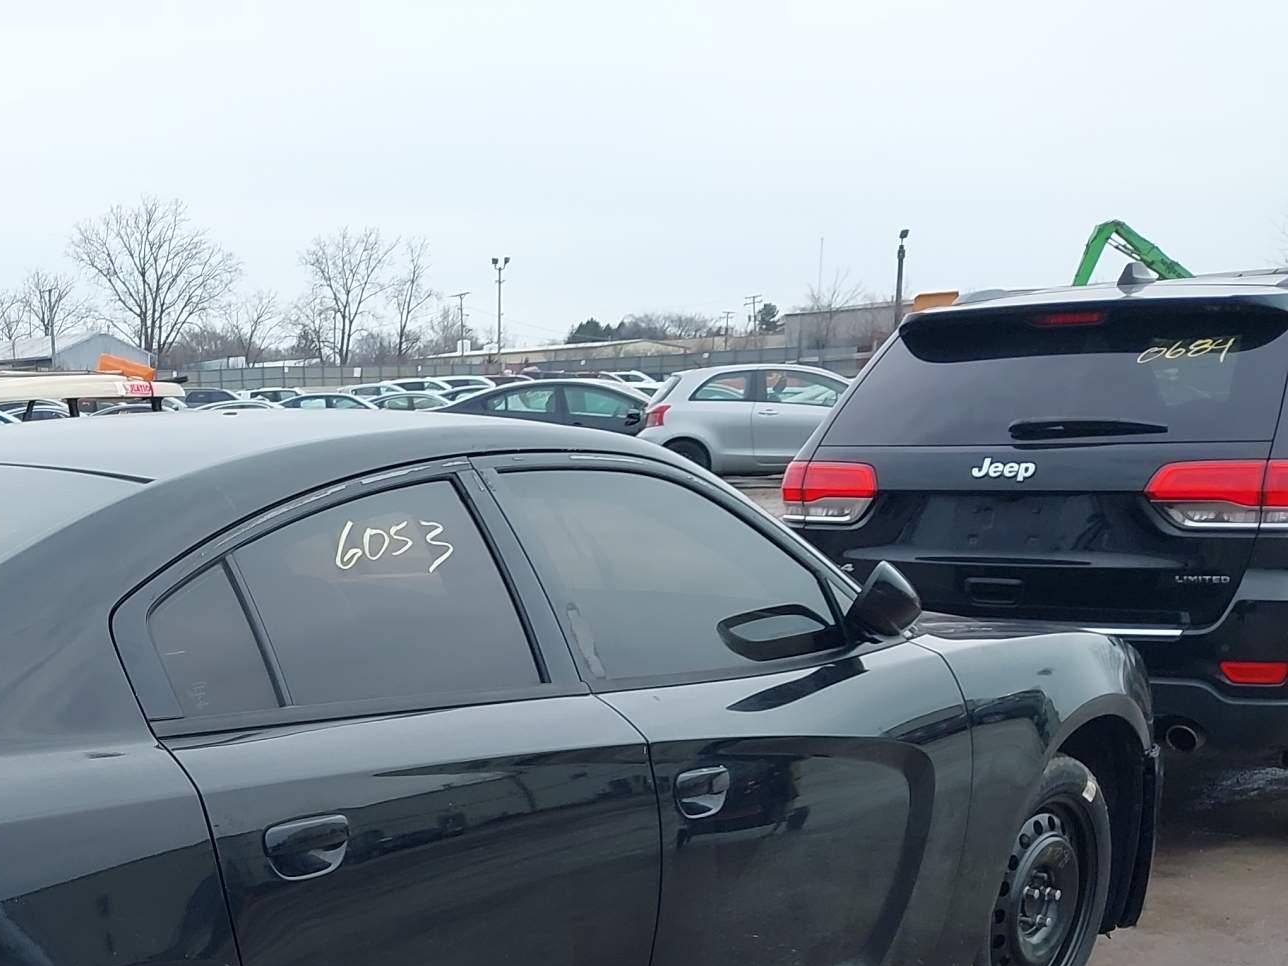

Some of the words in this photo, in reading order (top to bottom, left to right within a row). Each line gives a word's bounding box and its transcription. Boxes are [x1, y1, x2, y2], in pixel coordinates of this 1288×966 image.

[1137, 337, 1235, 363] 0684
[971, 457, 1036, 481] Jeep
[335, 520, 453, 573] 6053
[1175, 575, 1230, 583] LIMITED
